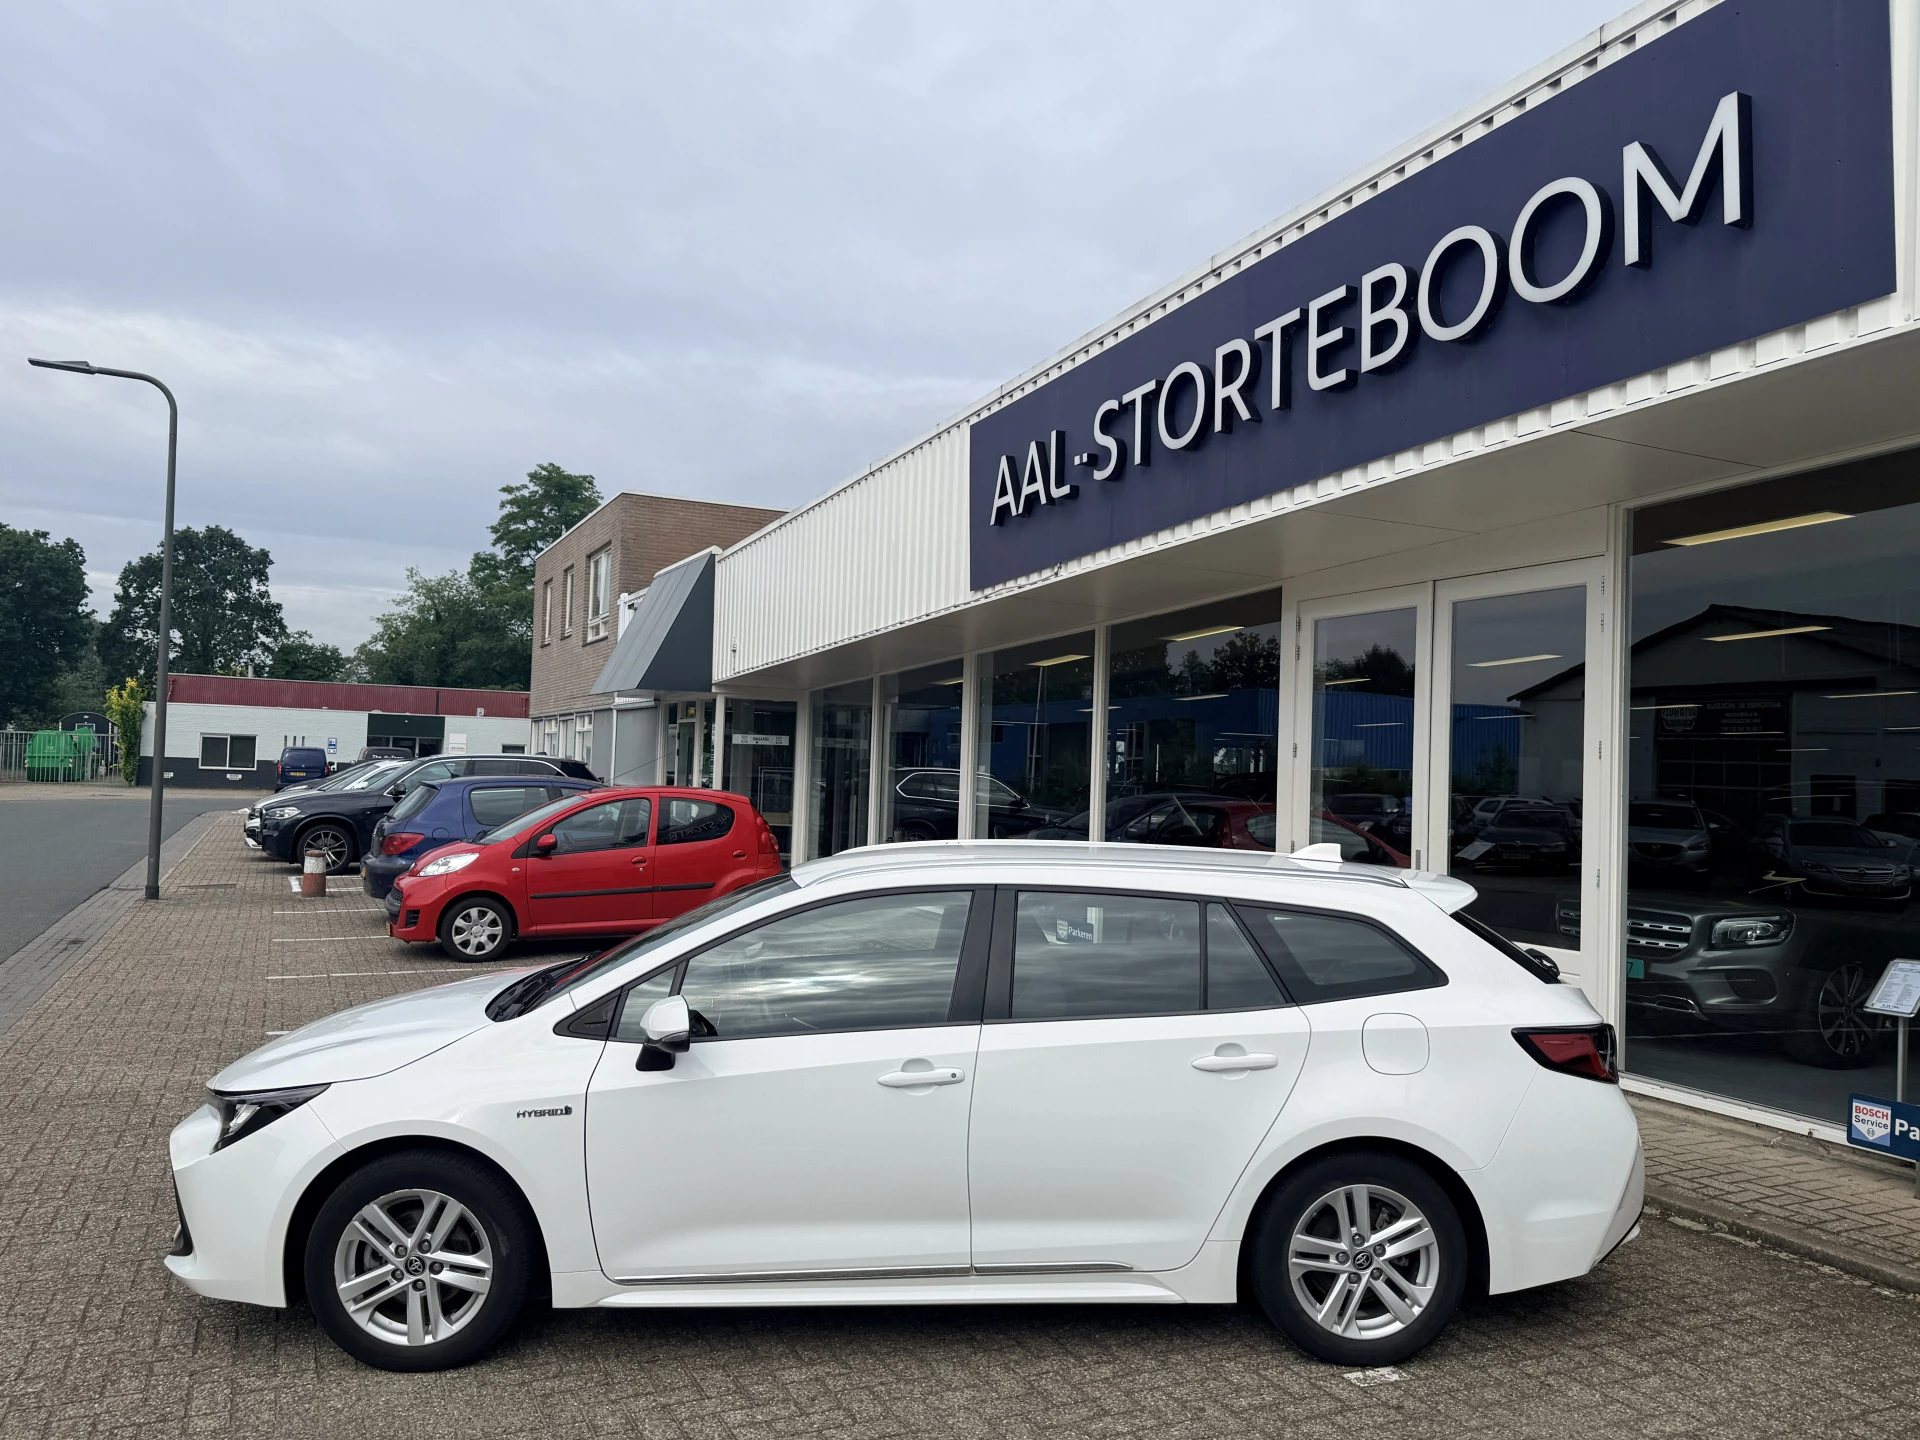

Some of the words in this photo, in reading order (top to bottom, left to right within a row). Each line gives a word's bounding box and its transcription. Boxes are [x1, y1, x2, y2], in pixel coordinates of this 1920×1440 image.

[1068, 926, 1093, 941] Parkeren
[516, 1107, 565, 1119] HYBRID
[1855, 1105, 1889, 1120] BOSCH
[1854, 1114, 1889, 1129] Service
